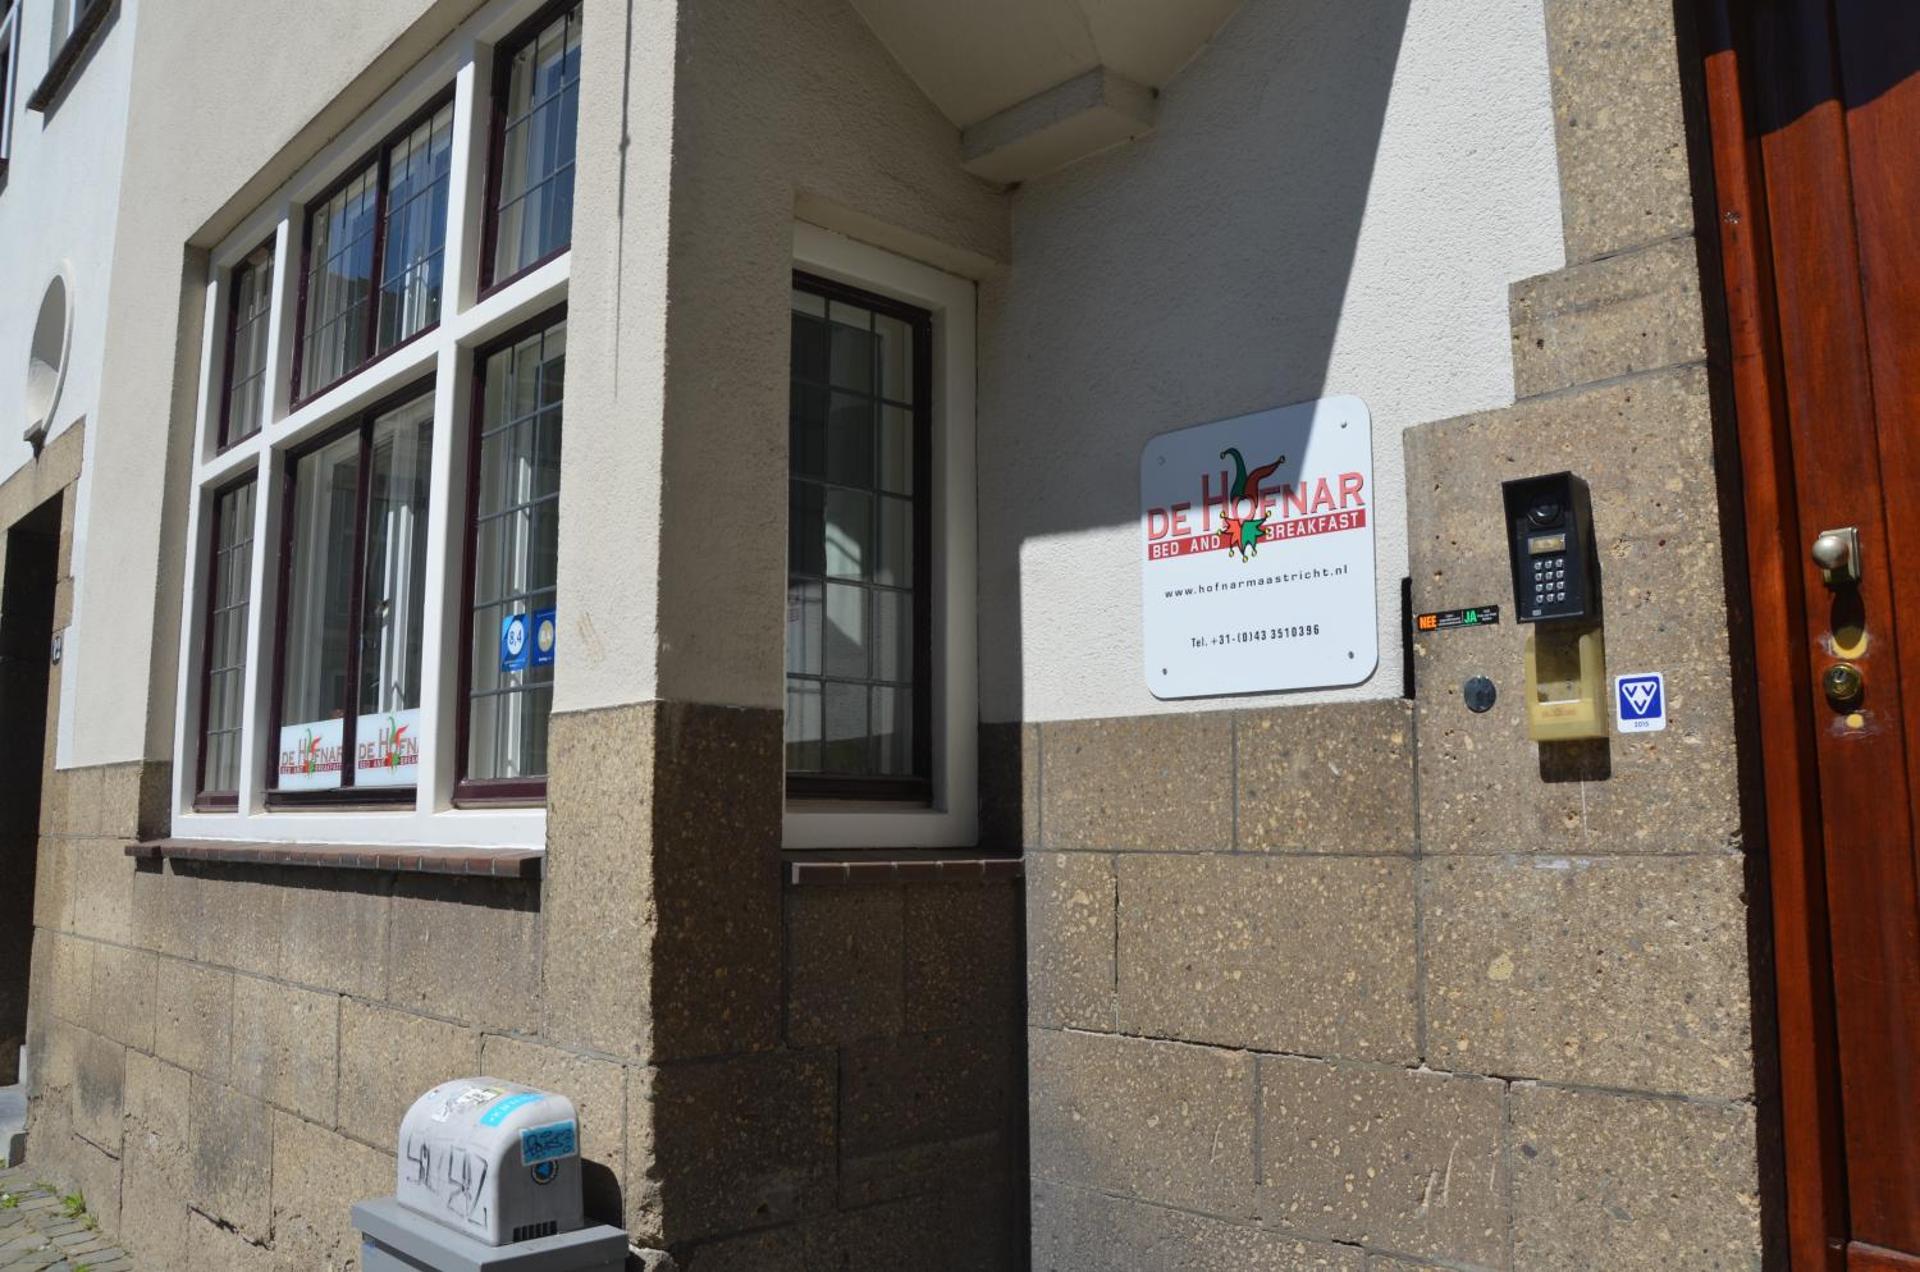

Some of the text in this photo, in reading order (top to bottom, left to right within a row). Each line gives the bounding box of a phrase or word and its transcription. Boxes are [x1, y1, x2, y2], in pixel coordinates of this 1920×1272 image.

[1147, 470, 1365, 541] DE HOFNAR
[1152, 511, 1359, 559] BED AND BREAKFAST
[1164, 564, 1348, 599] www.hofnarmaastricht.nl
[1419, 615, 1437, 629] NEE
[1464, 610, 1478, 624] JA
[1190, 636, 1208, 649] Tel.
[1270, 623, 1320, 642] 3510396
[359, 742, 375, 759] DE
